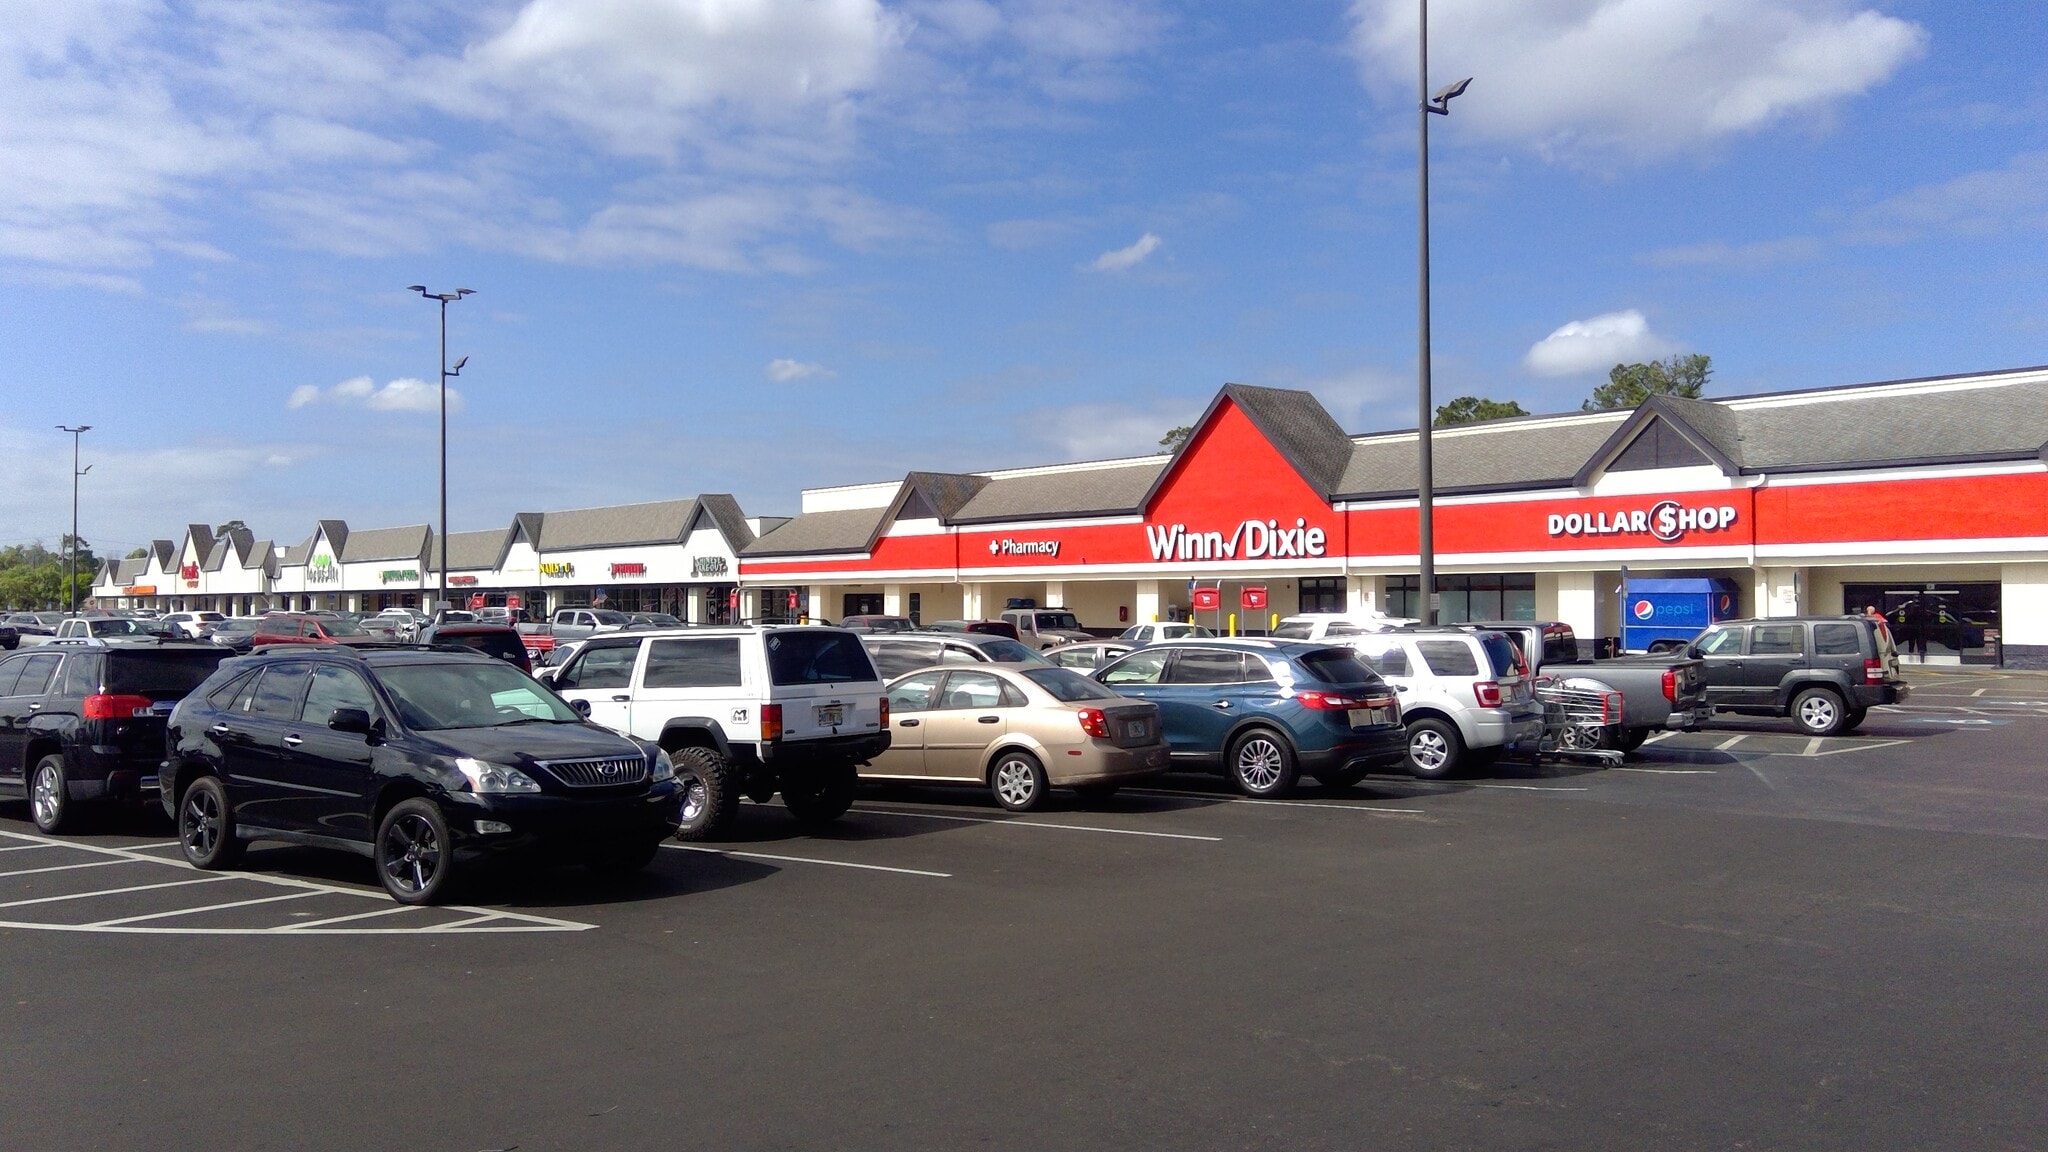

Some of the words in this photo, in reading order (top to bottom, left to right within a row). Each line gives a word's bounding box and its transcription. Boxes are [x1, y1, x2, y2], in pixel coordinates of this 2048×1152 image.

[1548, 509, 1648, 535] DOLLAR
[1002, 538, 1060, 557] Pharmacy
[1146, 523, 1223, 560] Winn
[1245, 517, 1326, 557] Dixie
[1656, 604, 1694, 616] pepsi
